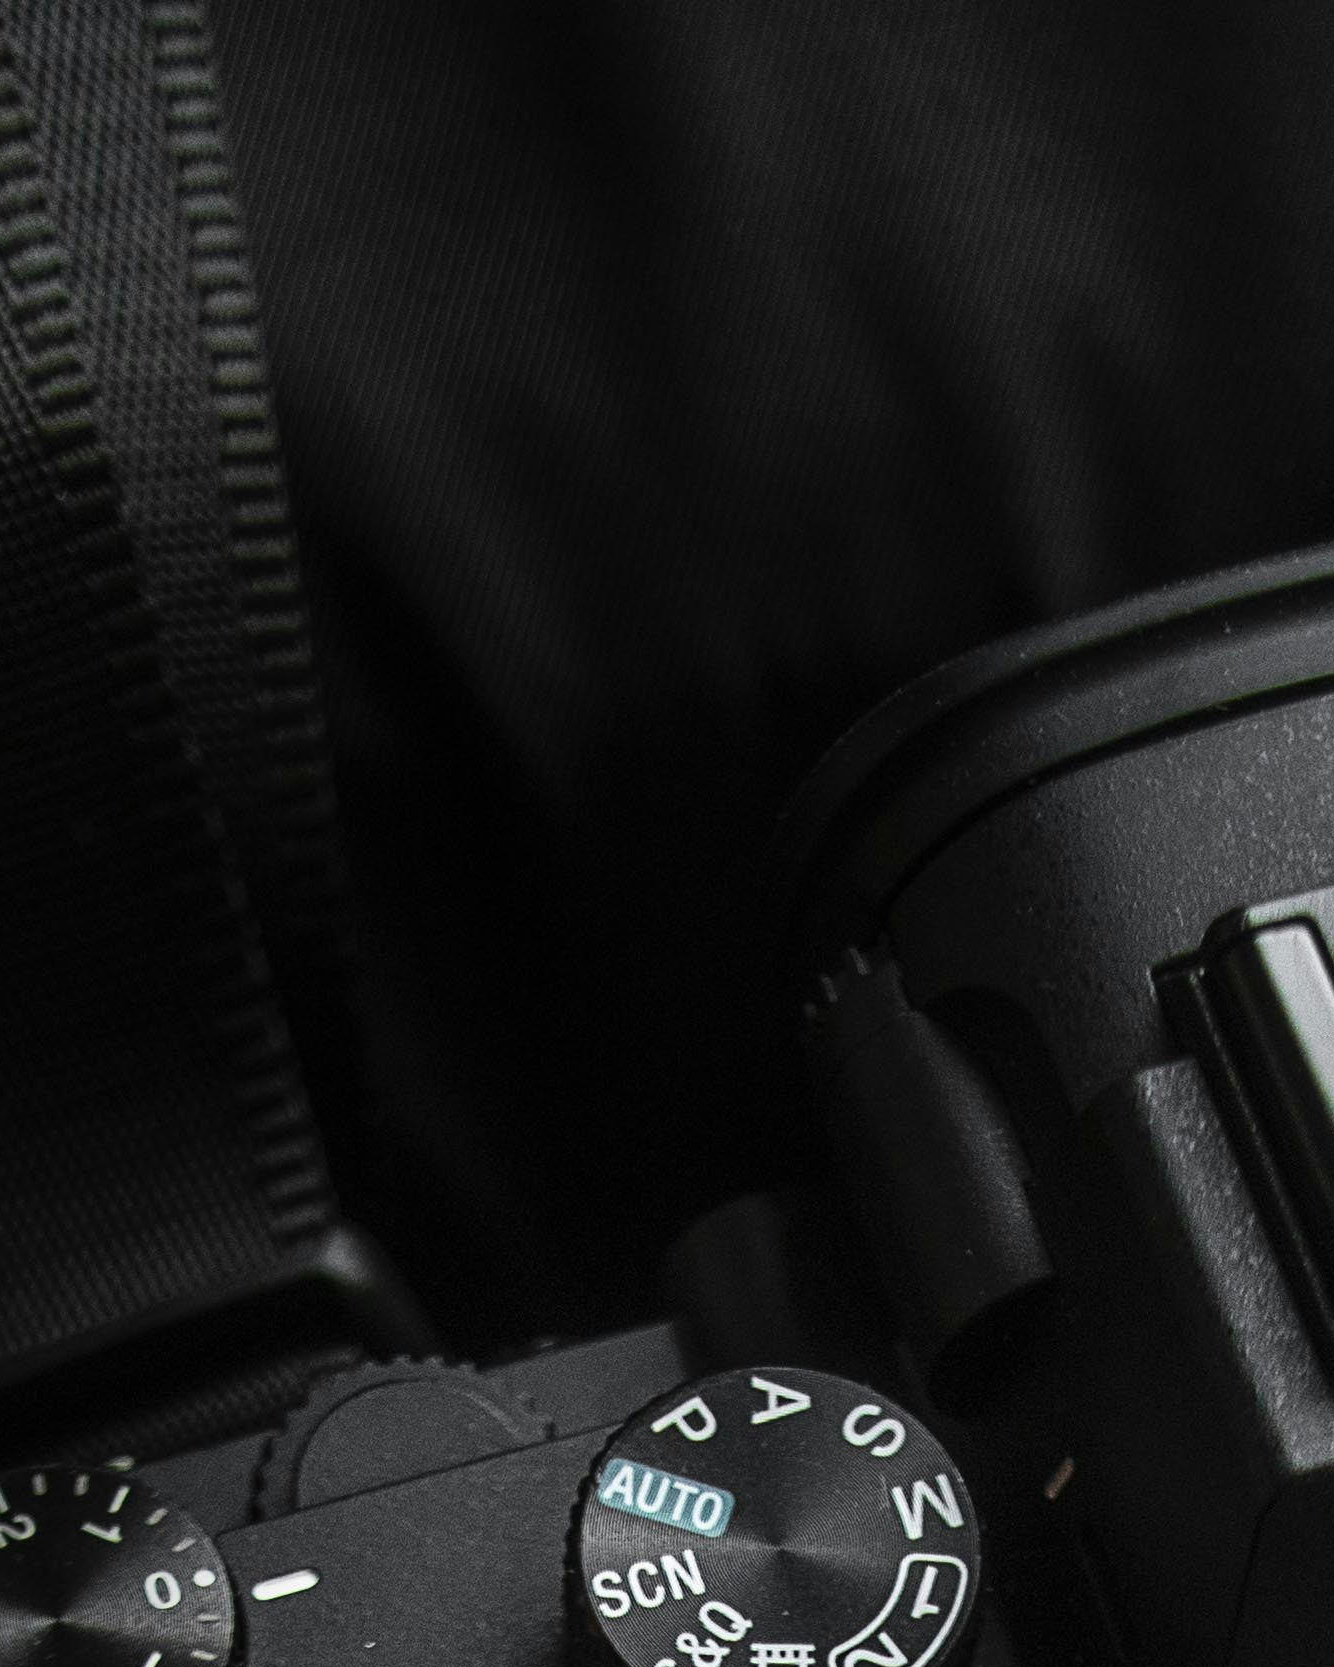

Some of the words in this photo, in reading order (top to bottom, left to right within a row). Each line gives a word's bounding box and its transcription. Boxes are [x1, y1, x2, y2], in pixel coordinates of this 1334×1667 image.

[650, 1396, 717, 1442] P
[751, 1376, 812, 1425] A
[842, 1404, 906, 1457] S
[603, 1465, 723, 1530] AUTO
[891, 1474, 964, 1540] M
[144, 1571, 182, 1610] 0
[592, 1549, 705, 1618] SCN
[911, 1565, 940, 1619] 1
